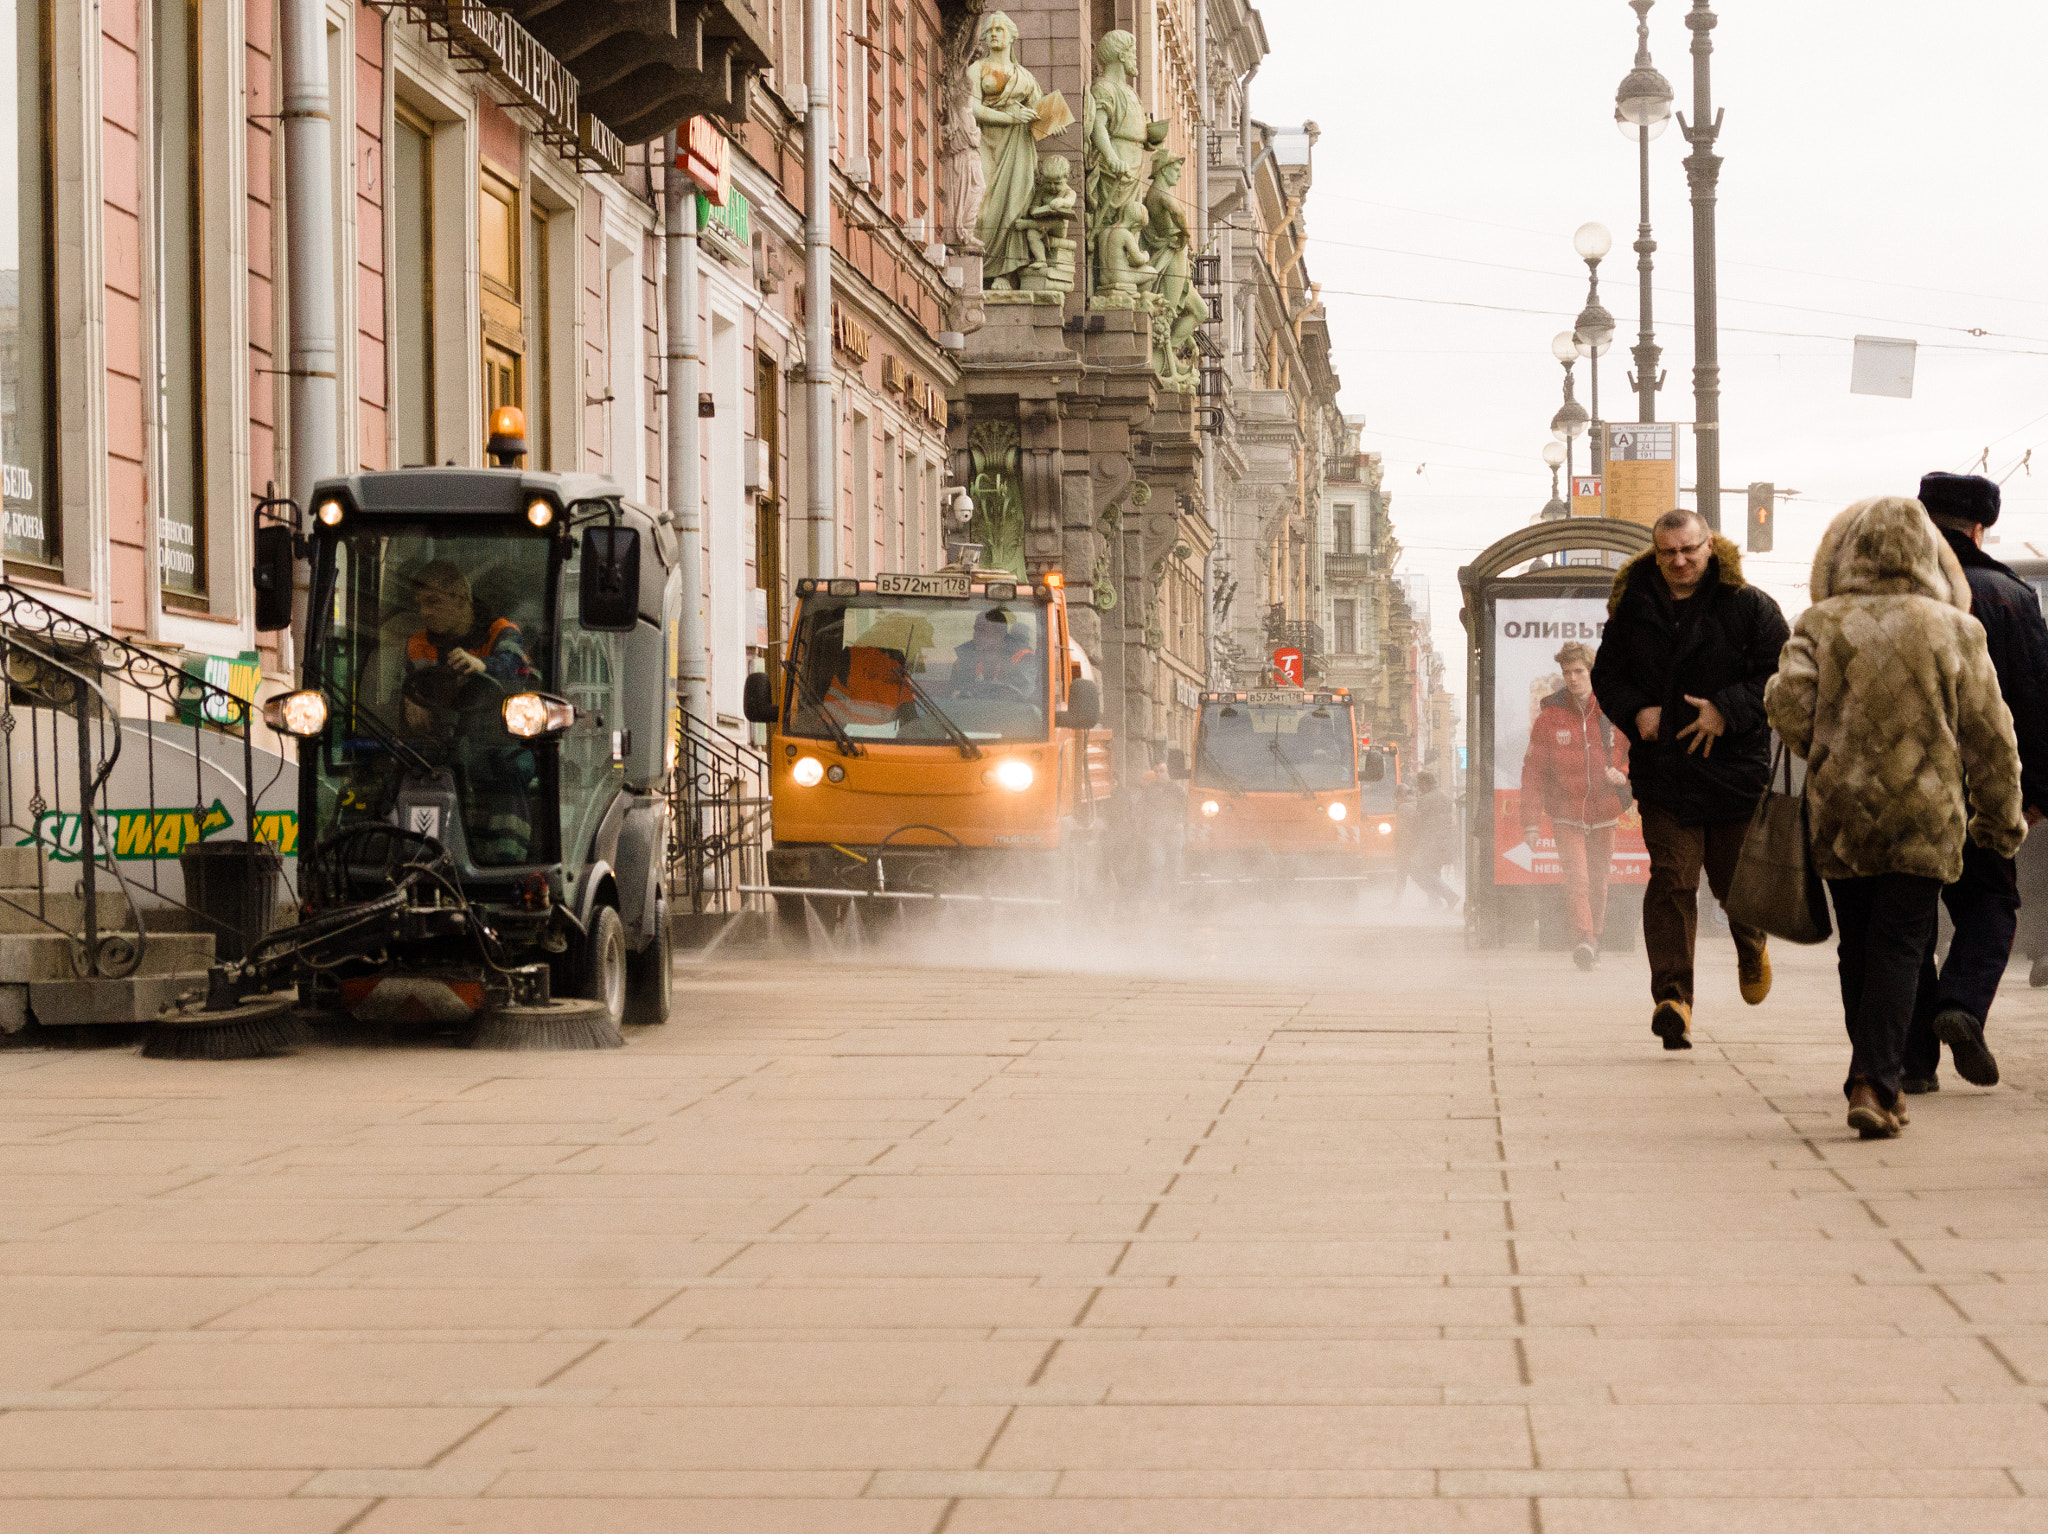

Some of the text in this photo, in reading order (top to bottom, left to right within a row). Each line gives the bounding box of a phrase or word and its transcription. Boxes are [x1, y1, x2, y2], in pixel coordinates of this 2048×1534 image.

[502, 12, 579, 137] ПЕТЕРБУРГ
[1618, 433, 1629, 445] А
[12, 512, 44, 540] БРОНЗА
[882, 577, 966, 593] В572МТ 178
[38, 808, 230, 856] SUBWAY
[1625, 865, 1641, 875] 54
